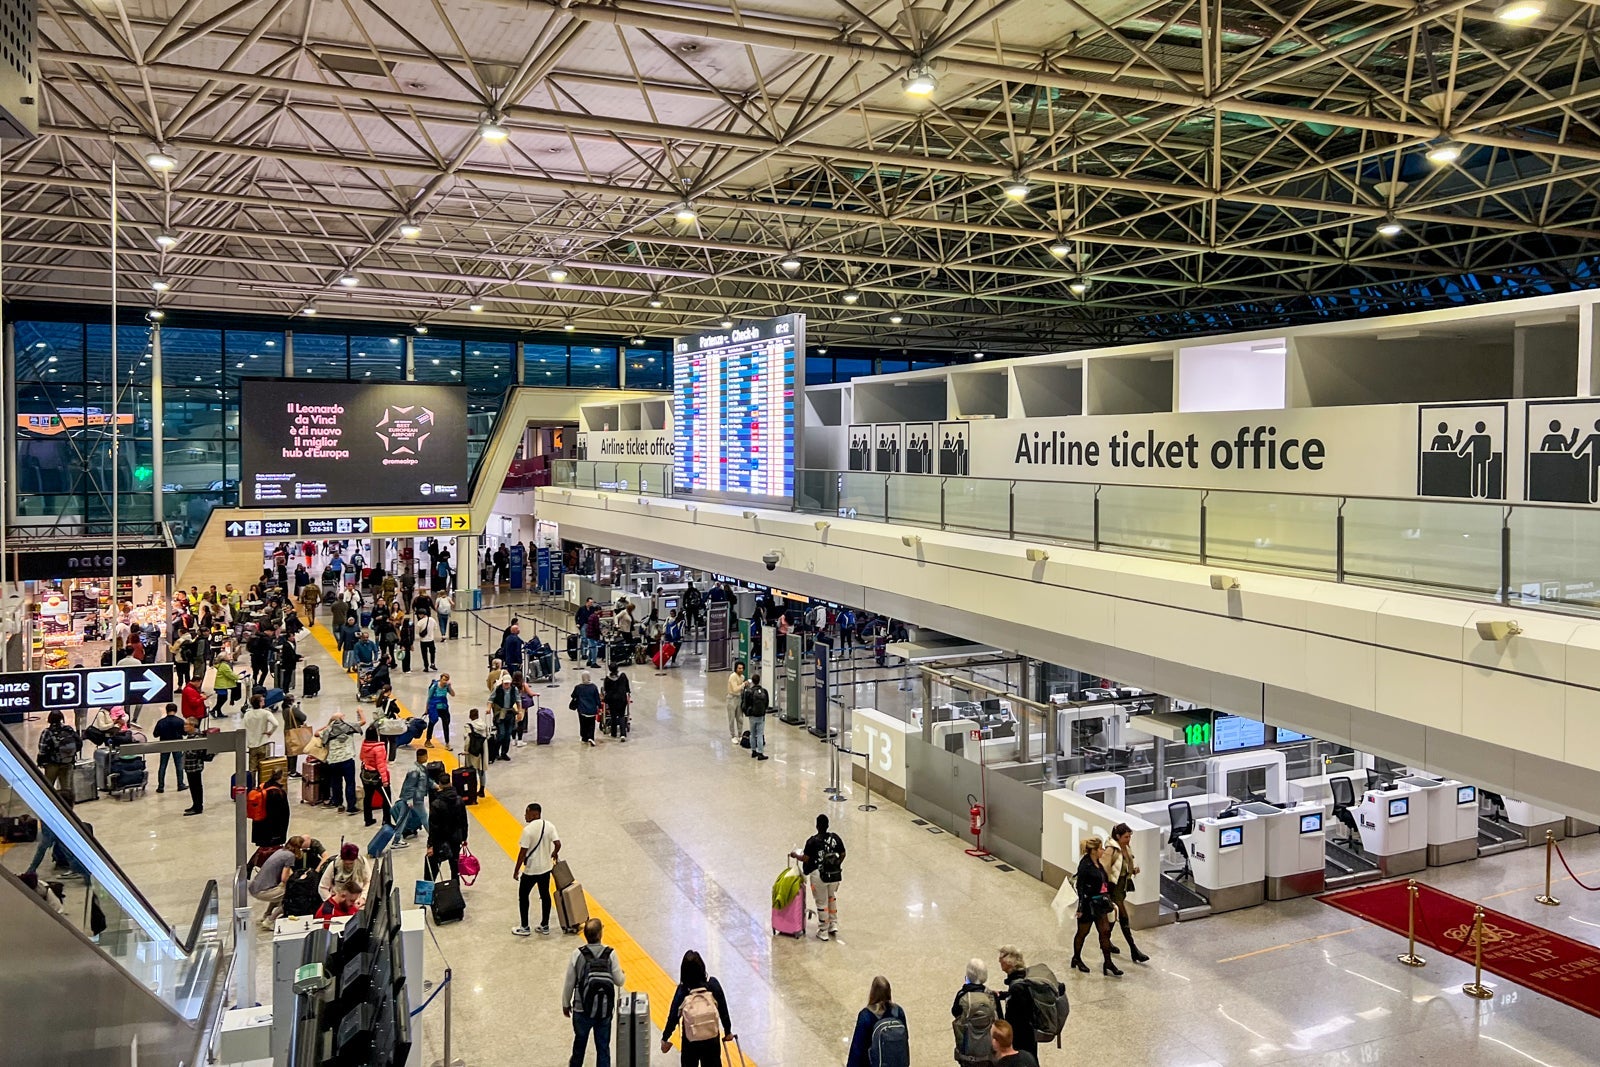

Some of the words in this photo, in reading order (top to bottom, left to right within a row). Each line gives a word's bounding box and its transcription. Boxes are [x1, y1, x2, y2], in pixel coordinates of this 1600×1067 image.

[732, 326, 760, 342] Check-in
[287, 403, 294, 413] Il
[295, 403, 344, 414] Leonardo
[295, 414, 309, 424] da
[311, 414, 337, 425] Vinci
[289, 425, 297, 436] è
[298, 425, 308, 435] di
[310, 428, 342, 436] nuovo
[294, 436, 301, 446] il
[302, 436, 338, 450] miglior
[600, 438, 625, 454] Airline
[626, 437, 648, 455] ticket
[650, 437, 674, 456] office
[1014, 430, 1100, 467] Airline
[1109, 429, 1199, 469] ticket
[1210, 426, 1326, 471] office
[282, 447, 303, 457] hub
[304, 447, 349, 460] d'Europa
[265, 521, 291, 529] Check-in
[46, 681, 76, 700] T3
[1185, 722, 1211, 746] 181
[863, 724, 893, 772] T3
[1510, 947, 1560, 963] VIP
